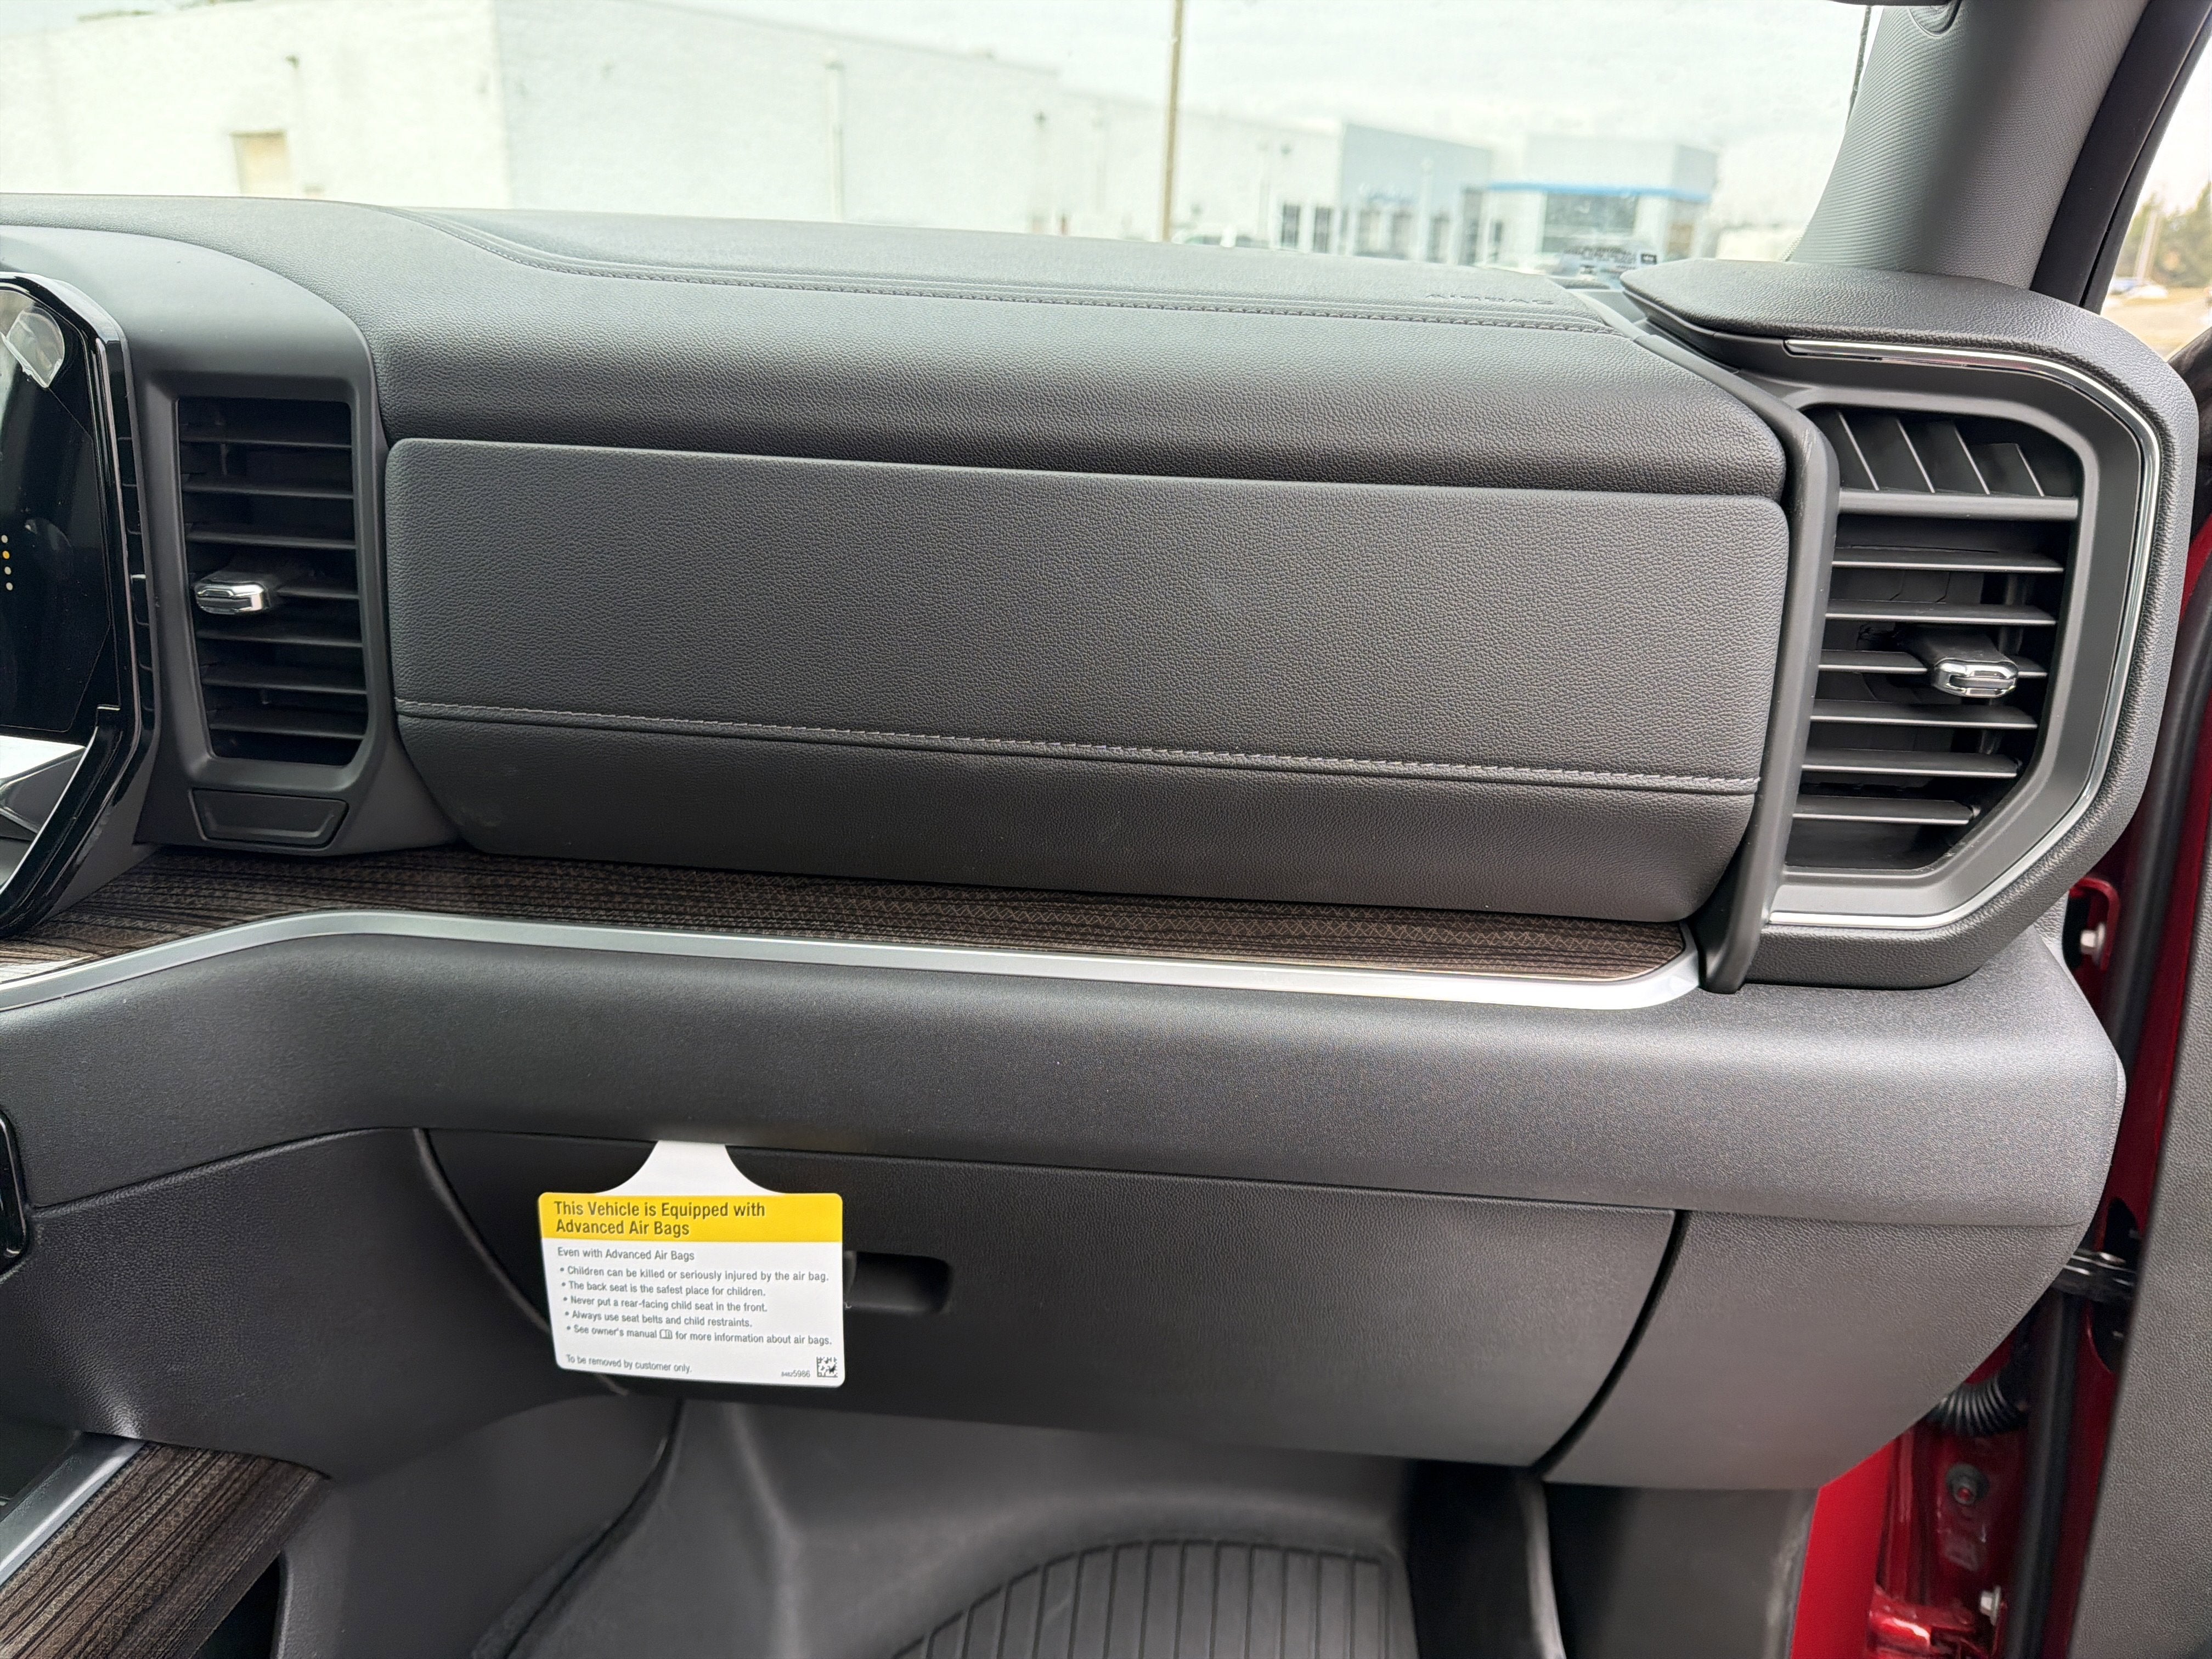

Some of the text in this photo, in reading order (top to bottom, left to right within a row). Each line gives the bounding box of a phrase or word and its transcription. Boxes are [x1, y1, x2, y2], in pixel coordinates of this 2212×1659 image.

[554, 1201, 765, 1220] This Vehicle is Equipped with
[556, 1219, 690, 1238] Advanced Air Bags
[557, 1247, 695, 1262] Even with Advanced Air Bags
[567, 1266, 604, 1276] Children
[627, 1268, 637, 1278] be
[640, 1269, 665, 1278] killed
[680, 1269, 722, 1282] seriously
[725, 1271, 757, 1282] injured
[761, 1271, 771, 1283] by
[775, 1272, 789, 1280] the
[793, 1272, 805, 1280] air
[809, 1272, 829, 1283] bag.
[569, 1280, 766, 1296] The back seat is the safest place for children.
[571, 1295, 594, 1305] Never
[597, 1298, 611, 1307] put
[621, 1299, 668, 1311] rear-facing
[671, 1301, 692, 1310] child
[695, 1302, 713, 1310] seat
[716, 1302, 724, 1311] in
[727, 1302, 741, 1311] the
[744, 1303, 768, 1312] front.
[572, 1310, 602, 1322] Always
[622, 1314, 639, 1322] seat
[642, 1314, 663, 1324] belts
[665, 1316, 681, 1324] and
[684, 1316, 704, 1325] child
[708, 1318, 752, 1327] restraints.
[574, 1324, 589, 1334] See
[592, 1327, 624, 1336] owner's
[627, 1330, 657, 1339] manual
[675, 1331, 687, 1340] for
[714, 1332, 764, 1343] information
[767, 1334, 791, 1344] about
[794, 1335, 805, 1344] air
[808, 1335, 832, 1346] bags.
[567, 1354, 692, 1374] To be removed by customer only.
